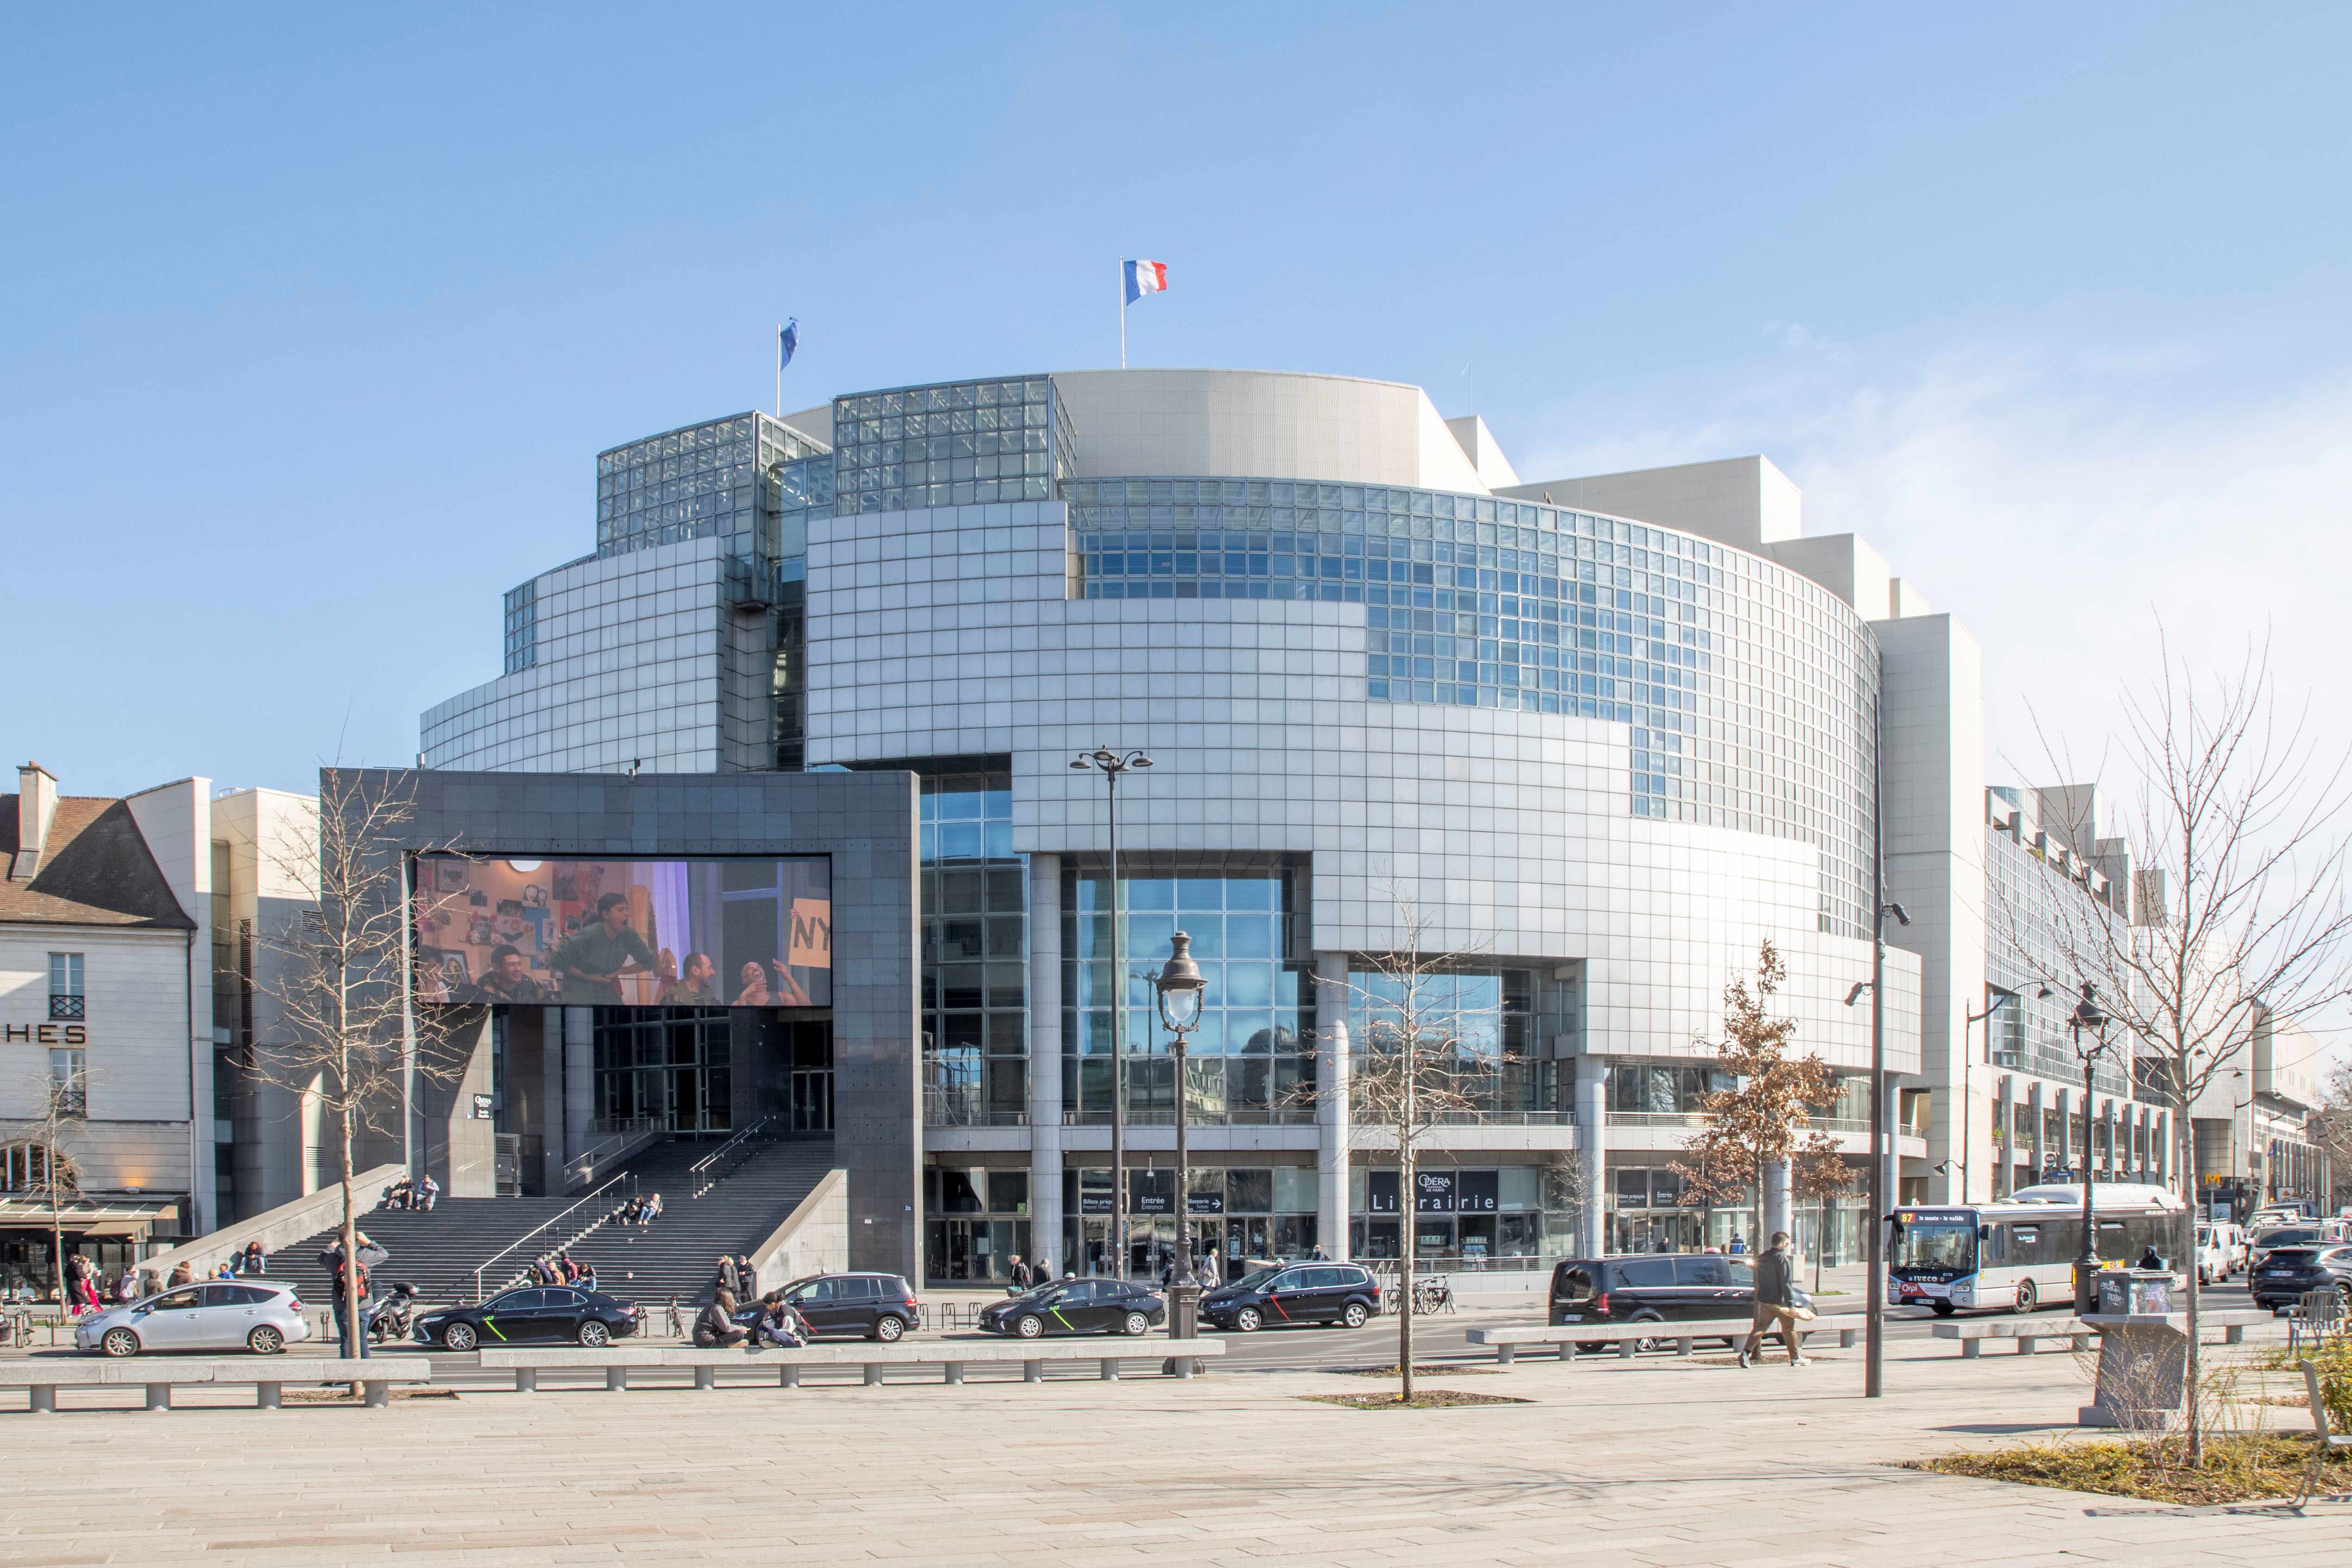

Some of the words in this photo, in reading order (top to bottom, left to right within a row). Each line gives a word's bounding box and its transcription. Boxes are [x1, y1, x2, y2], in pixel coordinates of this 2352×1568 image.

[7, 1024, 86, 1043] HES
[1418, 1174, 1451, 1188] OPÉRA
[2205, 1172, 2220, 1186] M
[1373, 1194, 1494, 1209] Lirairie
[1901, 1214, 1913, 1222] 87
[1902, 1284, 1918, 1293] Orpi
